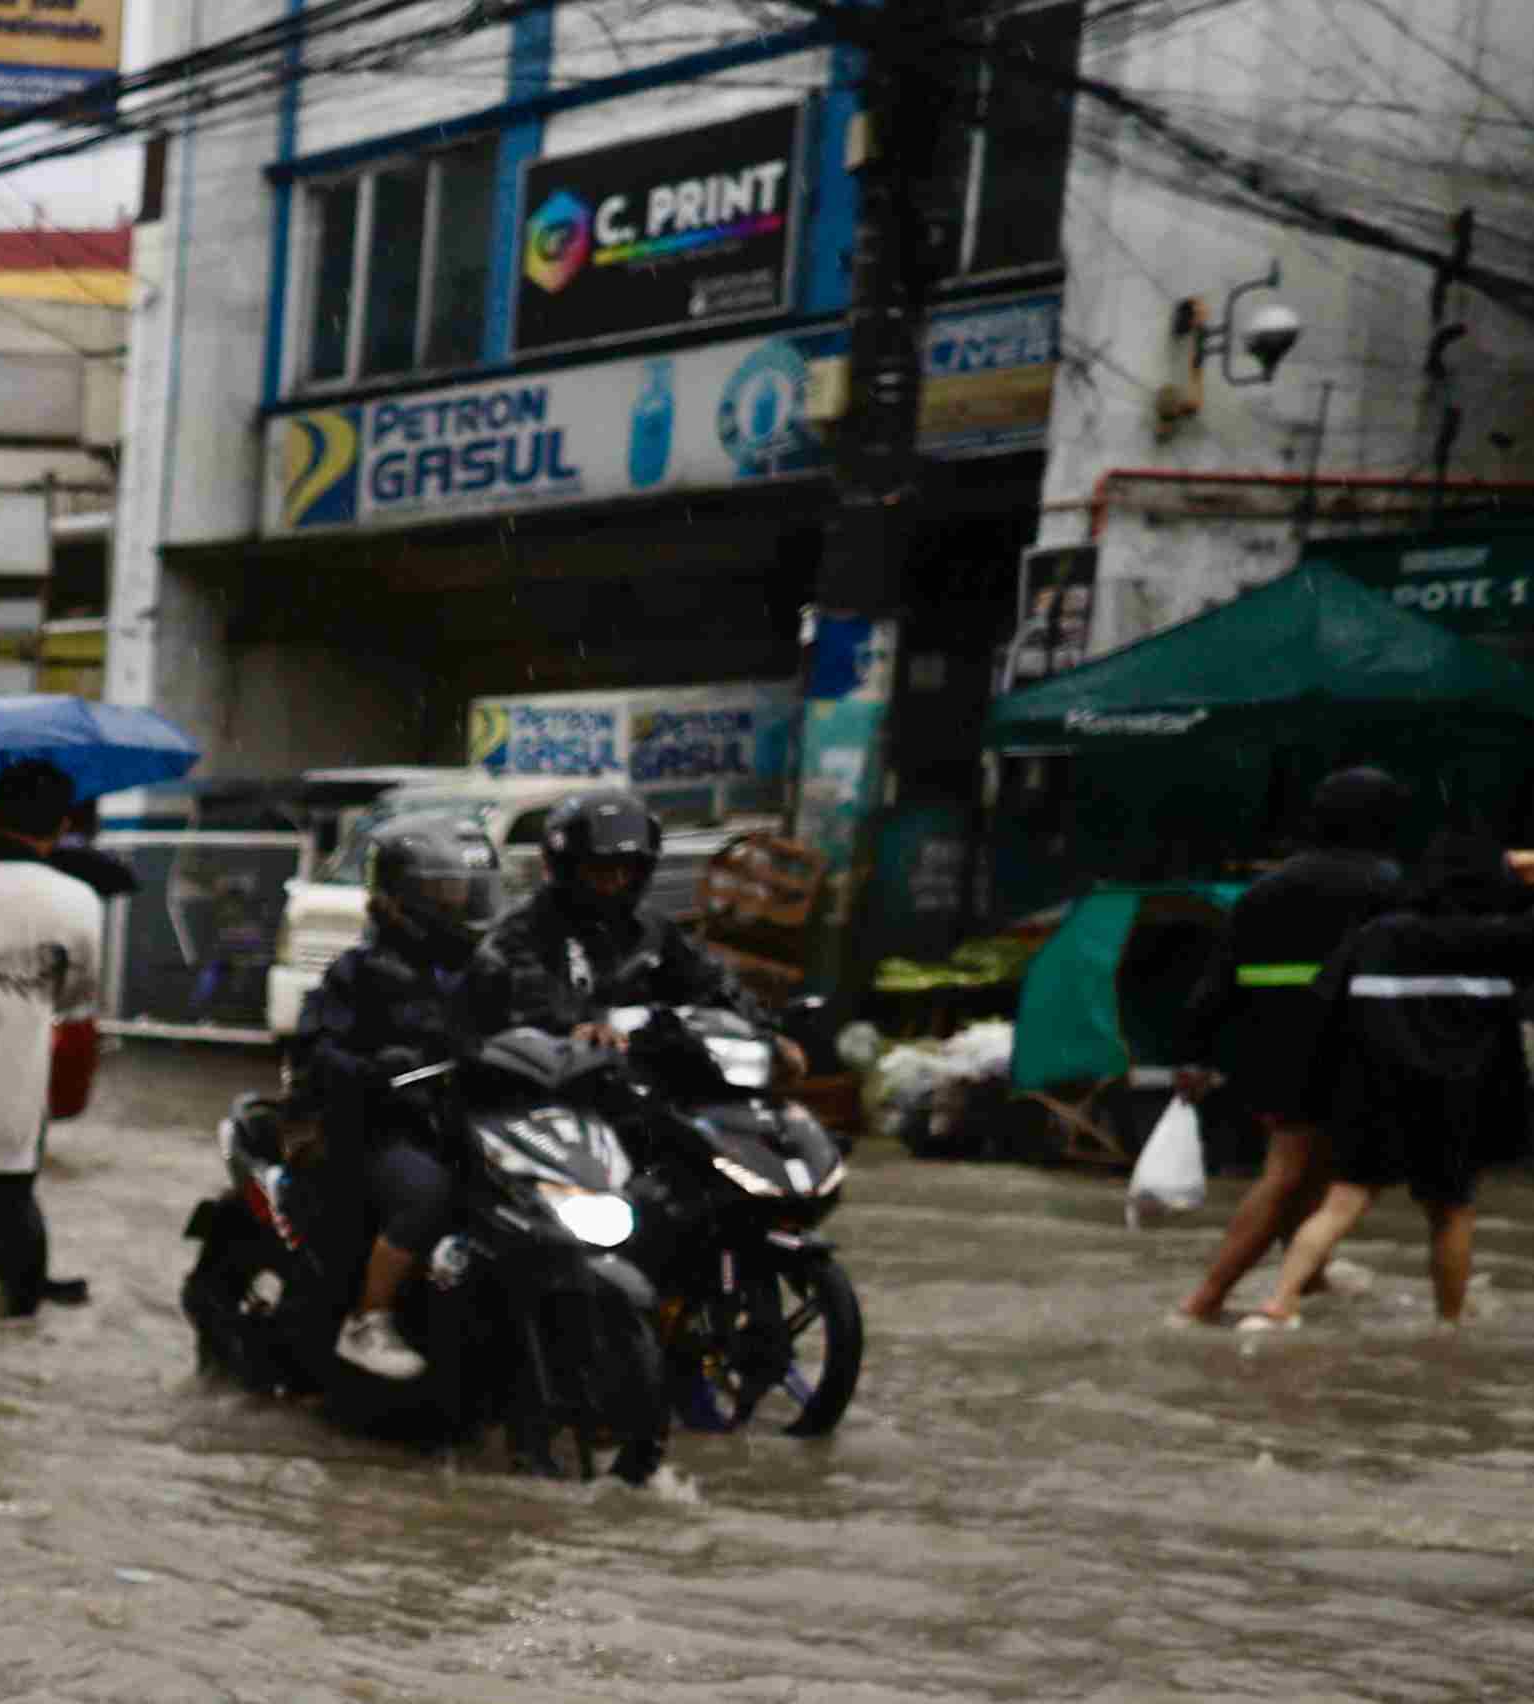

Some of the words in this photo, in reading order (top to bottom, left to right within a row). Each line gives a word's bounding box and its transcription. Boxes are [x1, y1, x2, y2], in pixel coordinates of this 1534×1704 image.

[594, 194, 636, 245] C.
[645, 158, 787, 237] PRINT
[372, 384, 549, 444] PETRON
[369, 430, 581, 501] GASUL
[515, 702, 616, 731] PETRON
[514, 734, 621, 776] GASUL
